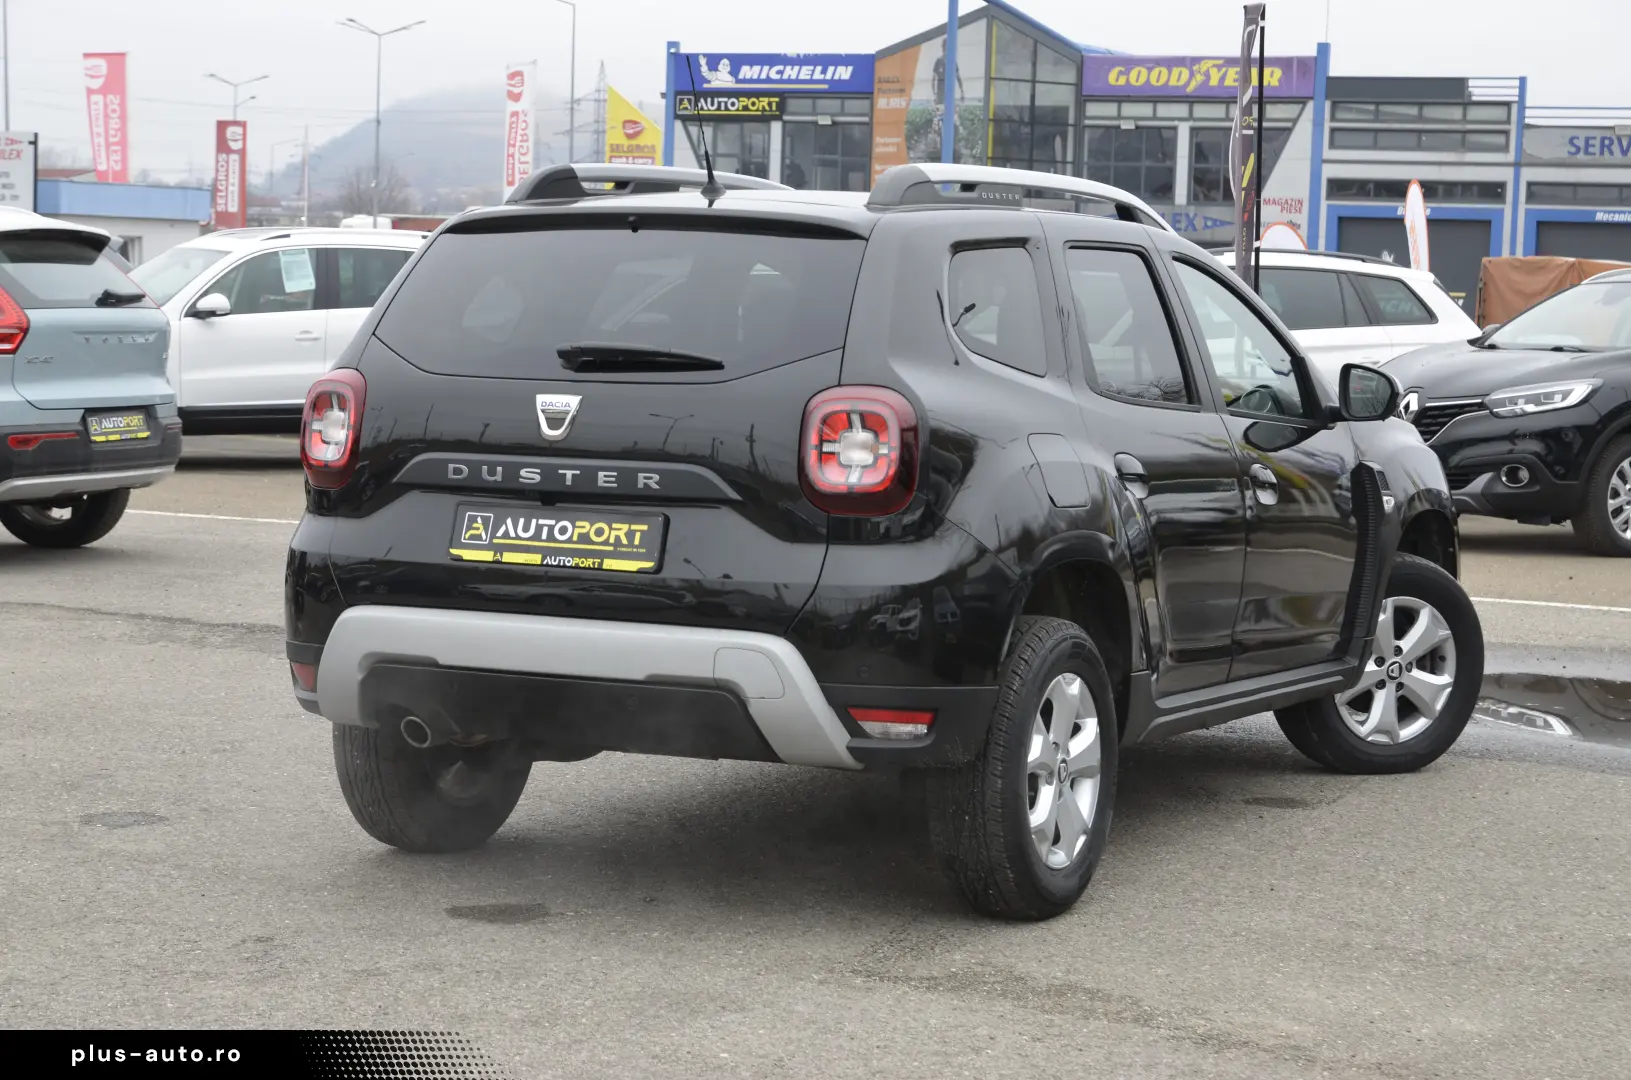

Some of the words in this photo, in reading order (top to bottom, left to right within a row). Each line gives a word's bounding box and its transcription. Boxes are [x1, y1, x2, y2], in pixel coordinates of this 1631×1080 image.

[738, 65, 853, 80] MICHELIN
[697, 97, 780, 111] AUTOPORT
[609, 144, 656, 153] SELGROS
[216, 153, 227, 212] SELGROS
[981, 192, 1020, 200] DUSTER
[1262, 198, 1303, 206] MAGAZIN
[1280, 206, 1303, 214] PIESE
[101, 415, 143, 429] AUTOPORT
[447, 463, 661, 489] DUSTER
[495, 516, 648, 545] AUTOPORT
[543, 556, 601, 568] AUTOPORT
